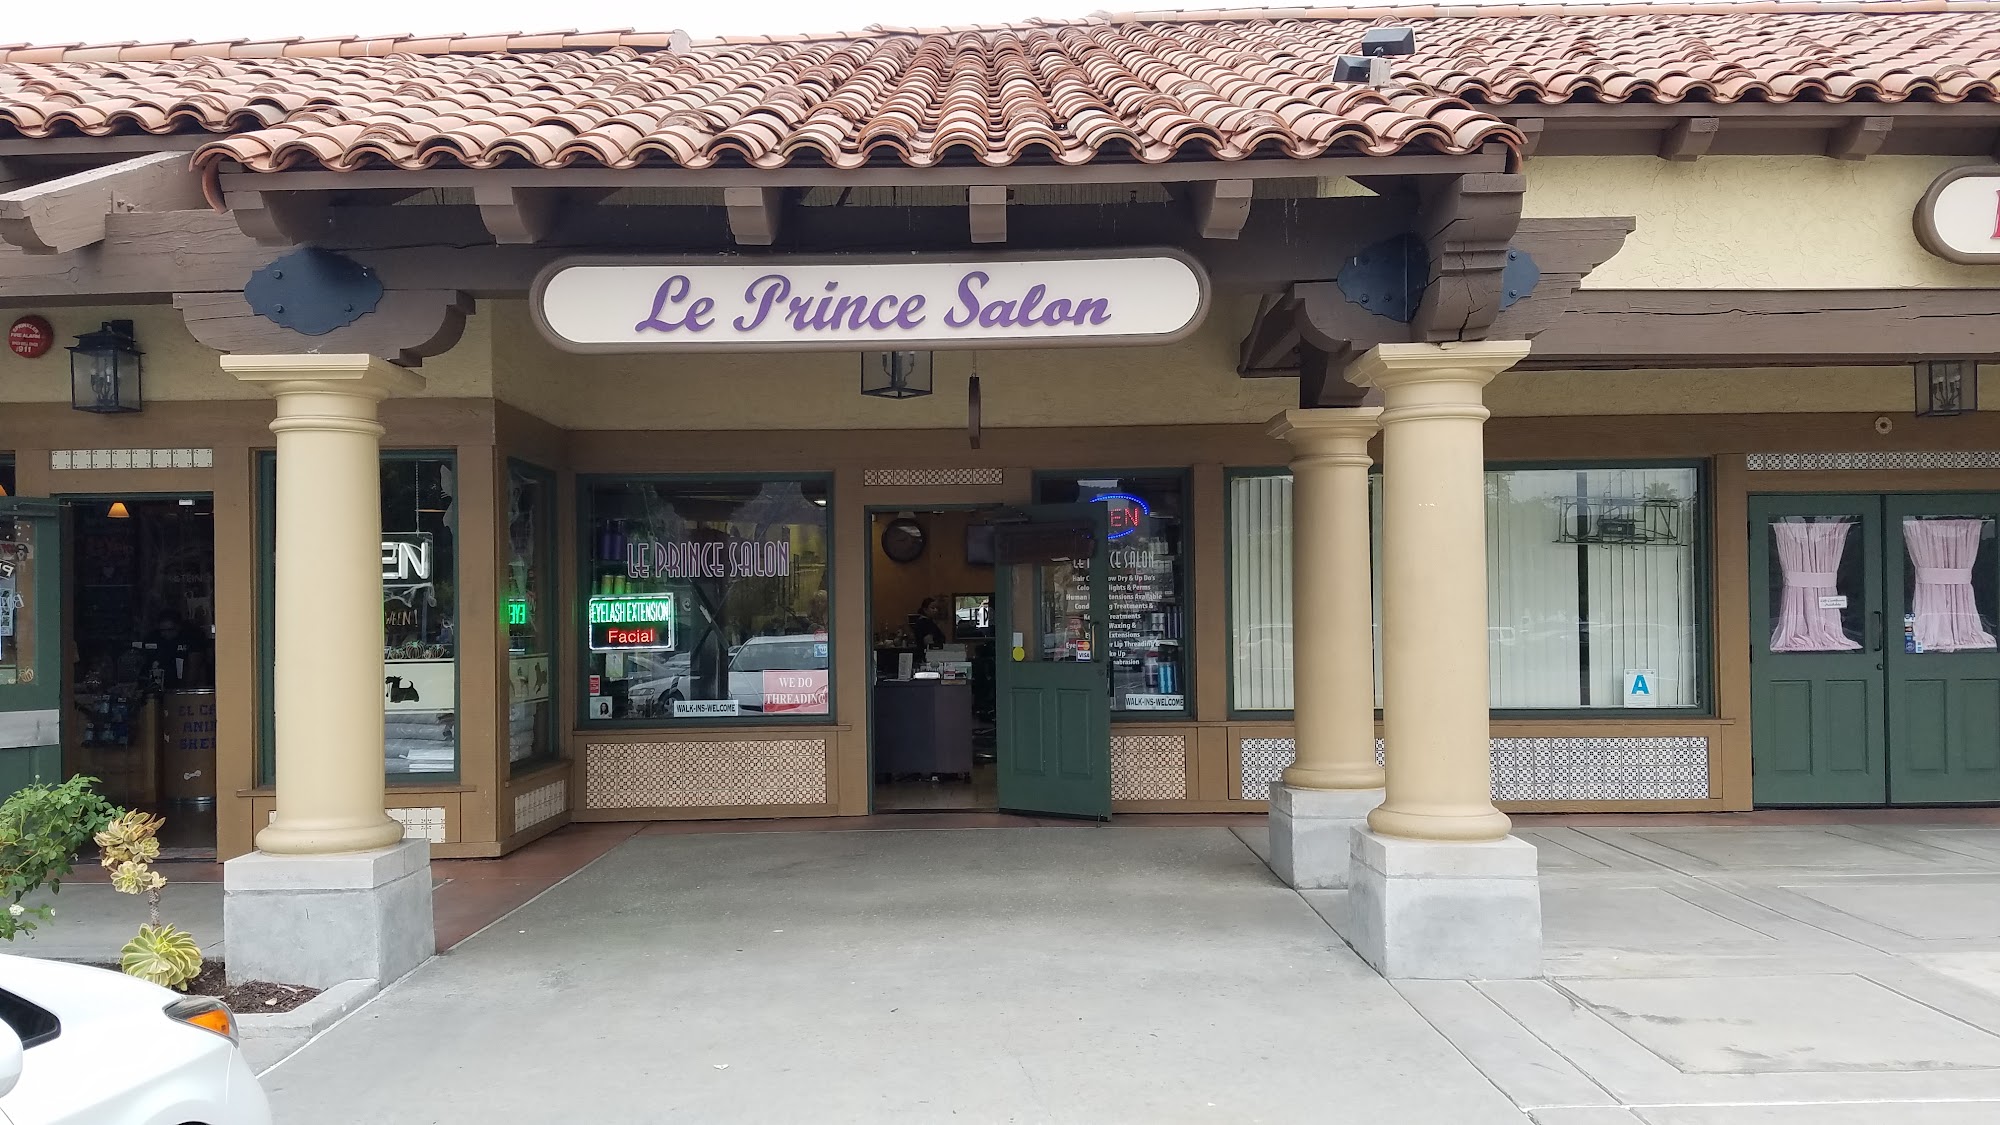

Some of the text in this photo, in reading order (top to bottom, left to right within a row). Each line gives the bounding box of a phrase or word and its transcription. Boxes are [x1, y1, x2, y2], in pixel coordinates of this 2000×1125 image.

[634, 271, 1111, 333] Le Prince Salon
[1110, 508, 1138, 526] EN
[382, 542, 430, 579] EN
[627, 540, 790, 579] LE PRINCE SALON
[1123, 550, 1154, 568] SALON
[1117, 575, 1128, 583] Dry
[1134, 574, 1143, 583] Up
[1108, 584, 1126, 592] lights
[591, 601, 669, 623] EYELASH EXTENSION
[1114, 602, 1148, 610] Treatments
[1109, 622, 1131, 630] Waxing
[608, 629, 653, 644] Facial
[1124, 641, 1154, 649] Threading
[779, 677, 813, 688] WE DO
[1631, 674, 1650, 695] A
[765, 693, 826, 705] THREADING
[1125, 697, 1184, 707] WALK-INS-WELCOME
[676, 704, 736, 713] WALK-INS-WELCOME
